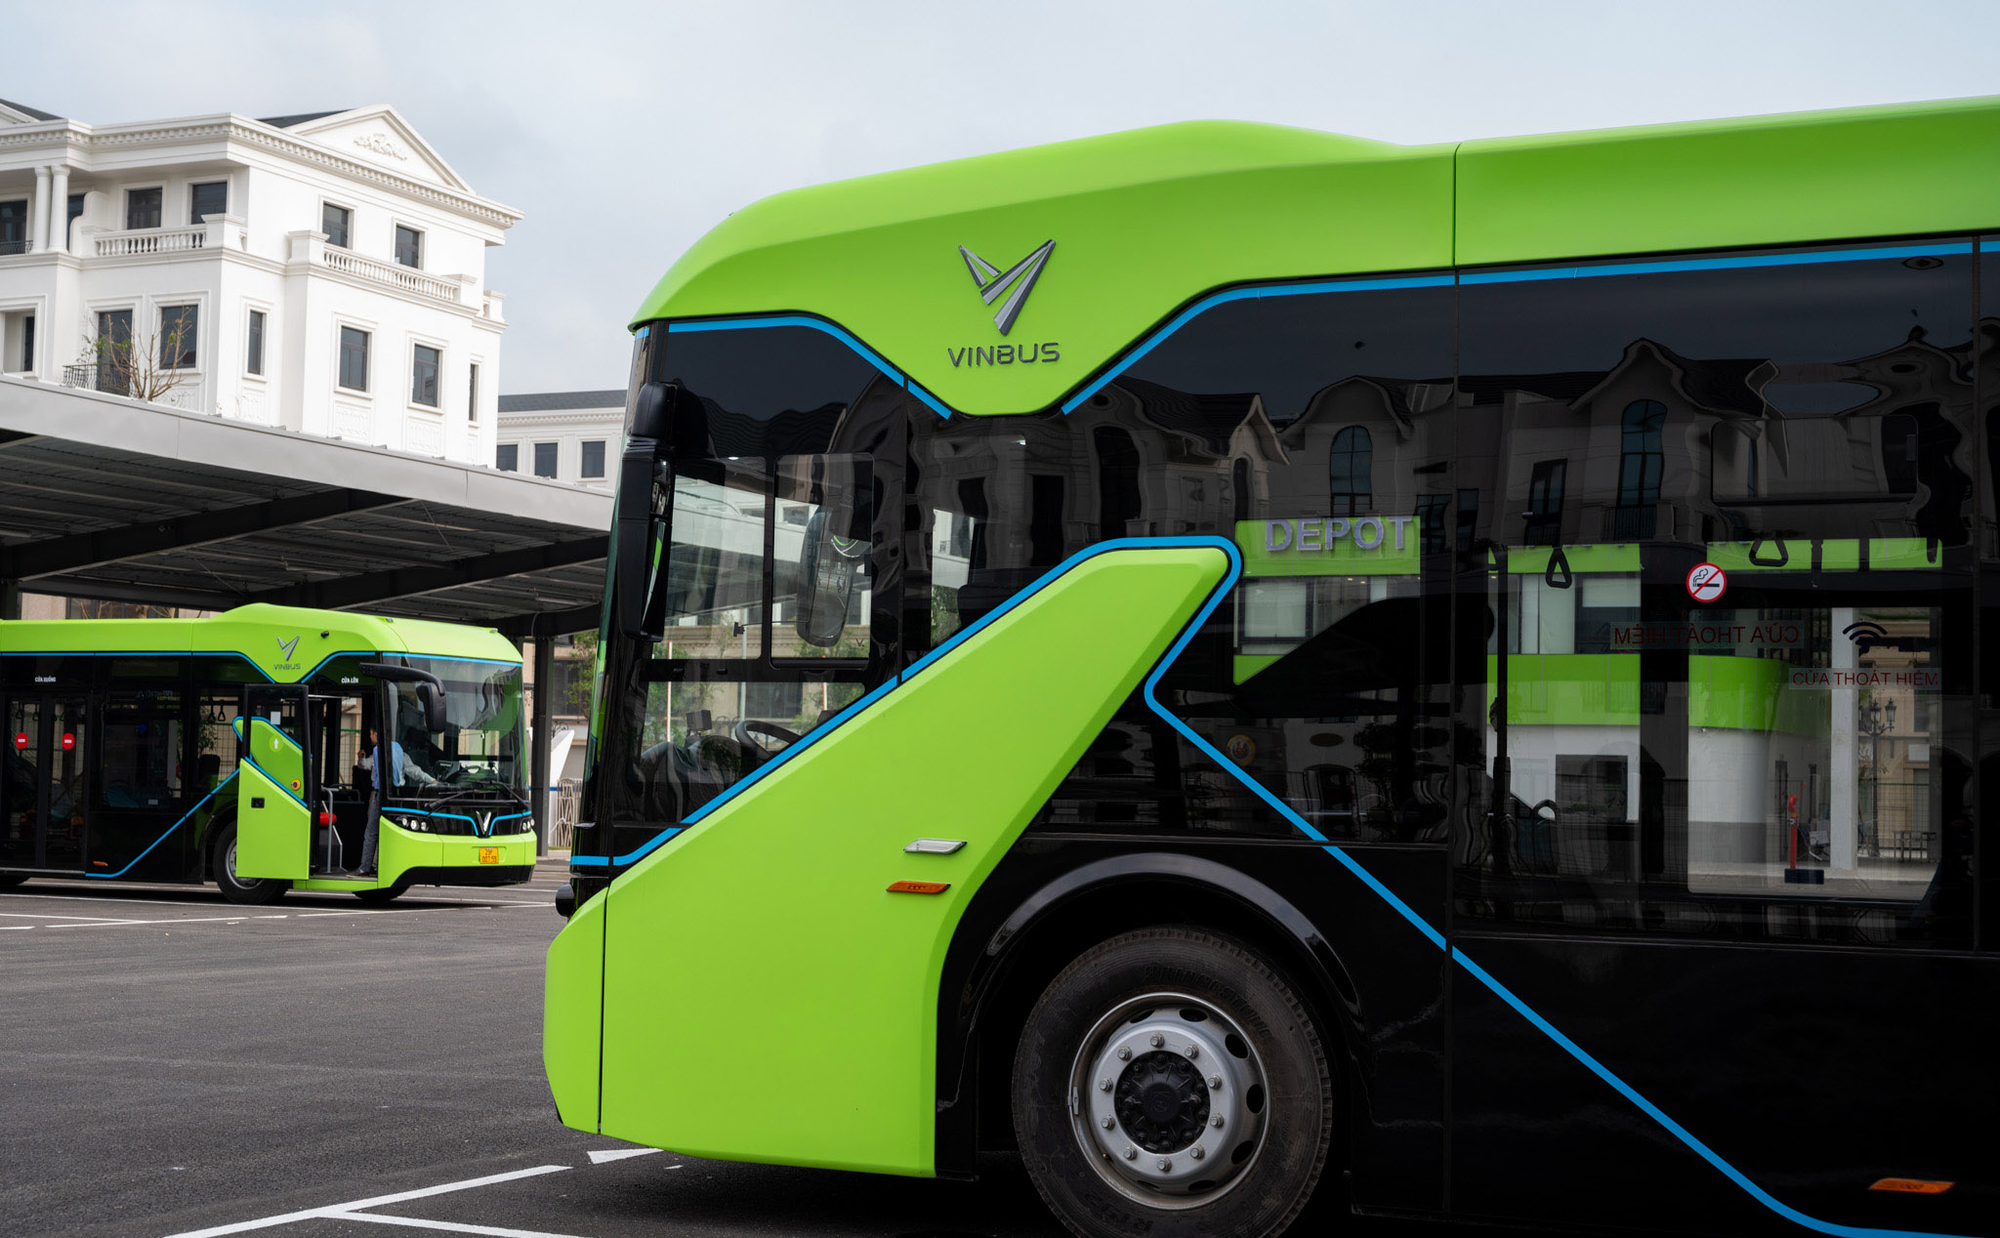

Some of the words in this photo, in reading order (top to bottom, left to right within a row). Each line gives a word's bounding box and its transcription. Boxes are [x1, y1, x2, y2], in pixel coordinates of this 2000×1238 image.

[947, 342, 1061, 368] VINBUS
[1265, 515, 1413, 551] DEPOT
[1792, 669, 1830, 686] CỬA
[1833, 669, 1891, 686] THOÁT
